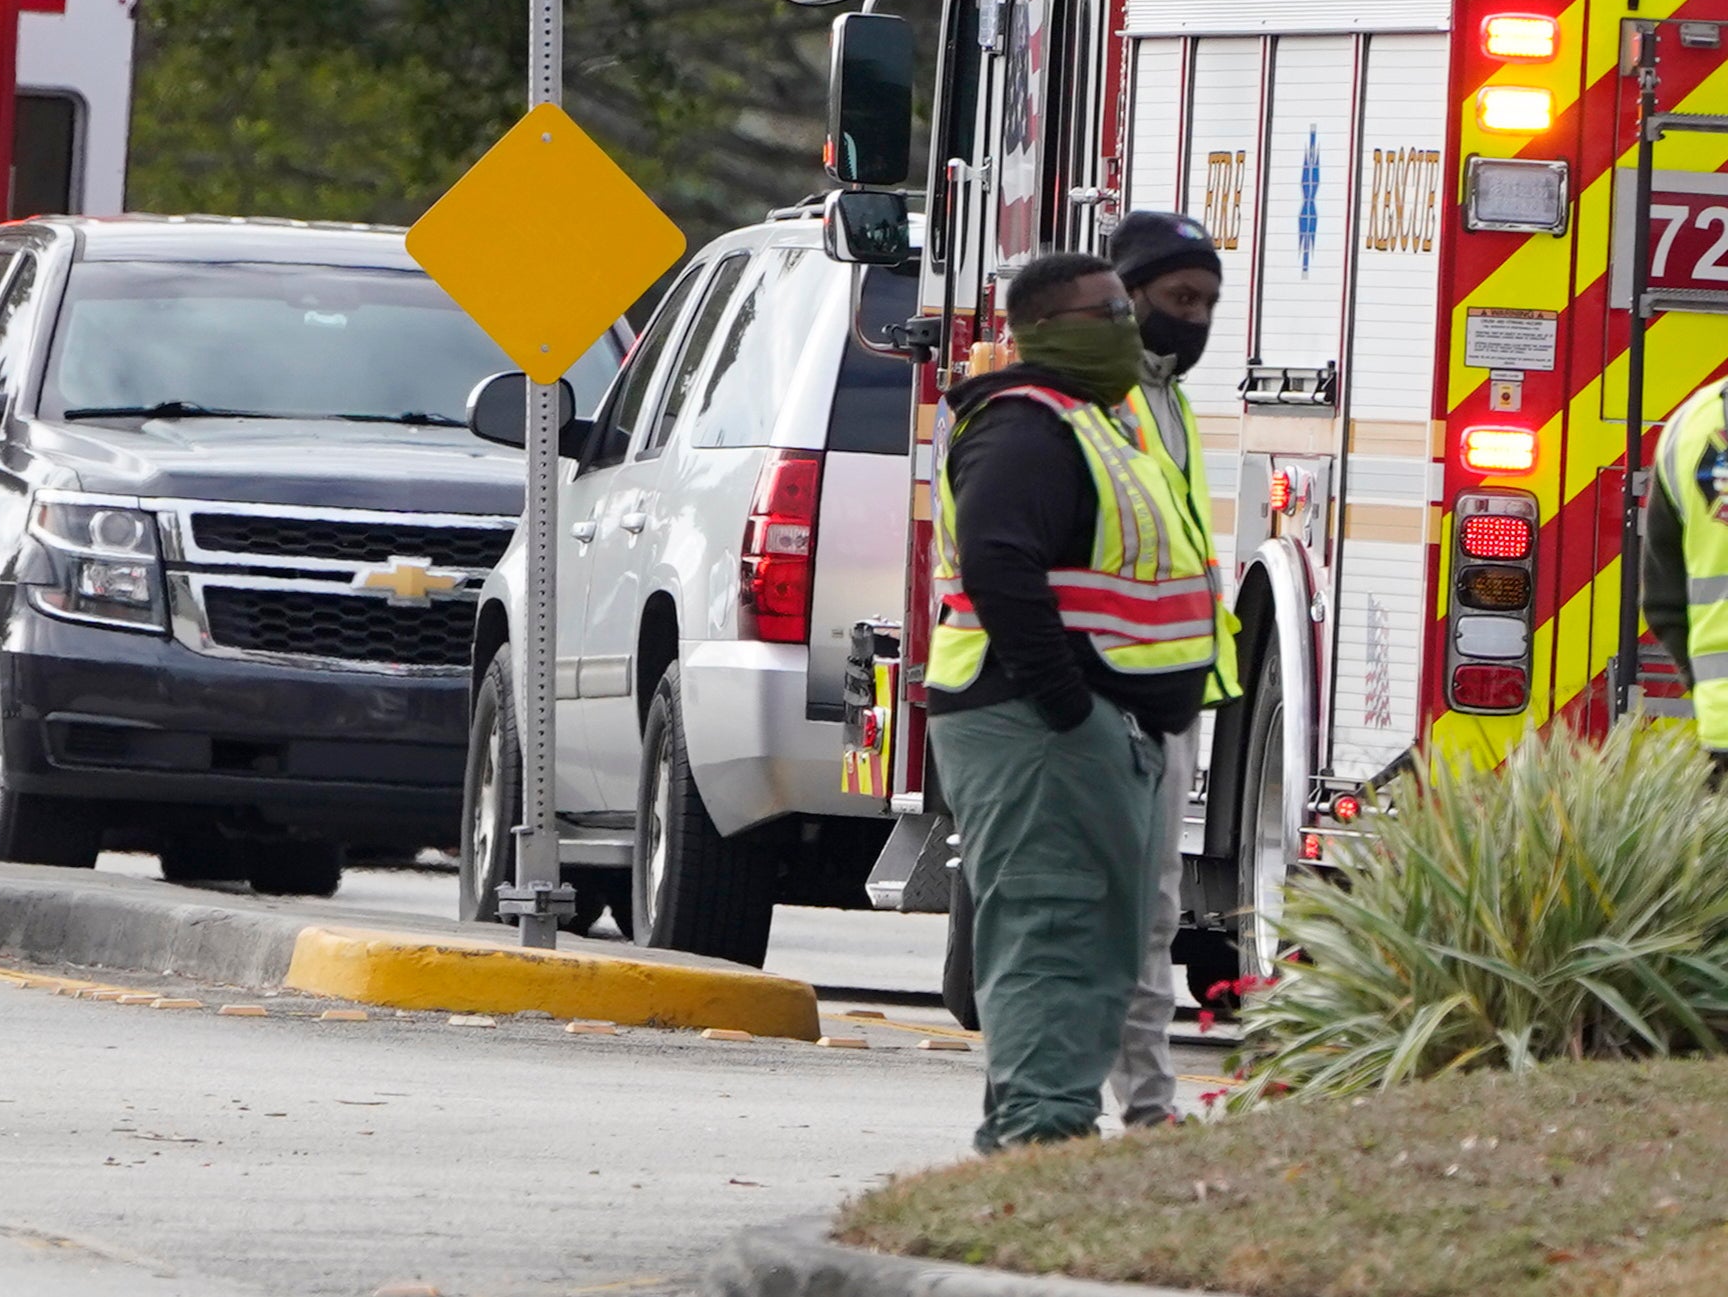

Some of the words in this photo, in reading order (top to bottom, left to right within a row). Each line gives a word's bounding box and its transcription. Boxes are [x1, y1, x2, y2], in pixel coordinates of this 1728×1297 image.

[1204, 150, 1246, 250] FIRE
[1366, 146, 1440, 253] RESCUE
[1649, 204, 1728, 282] 72
